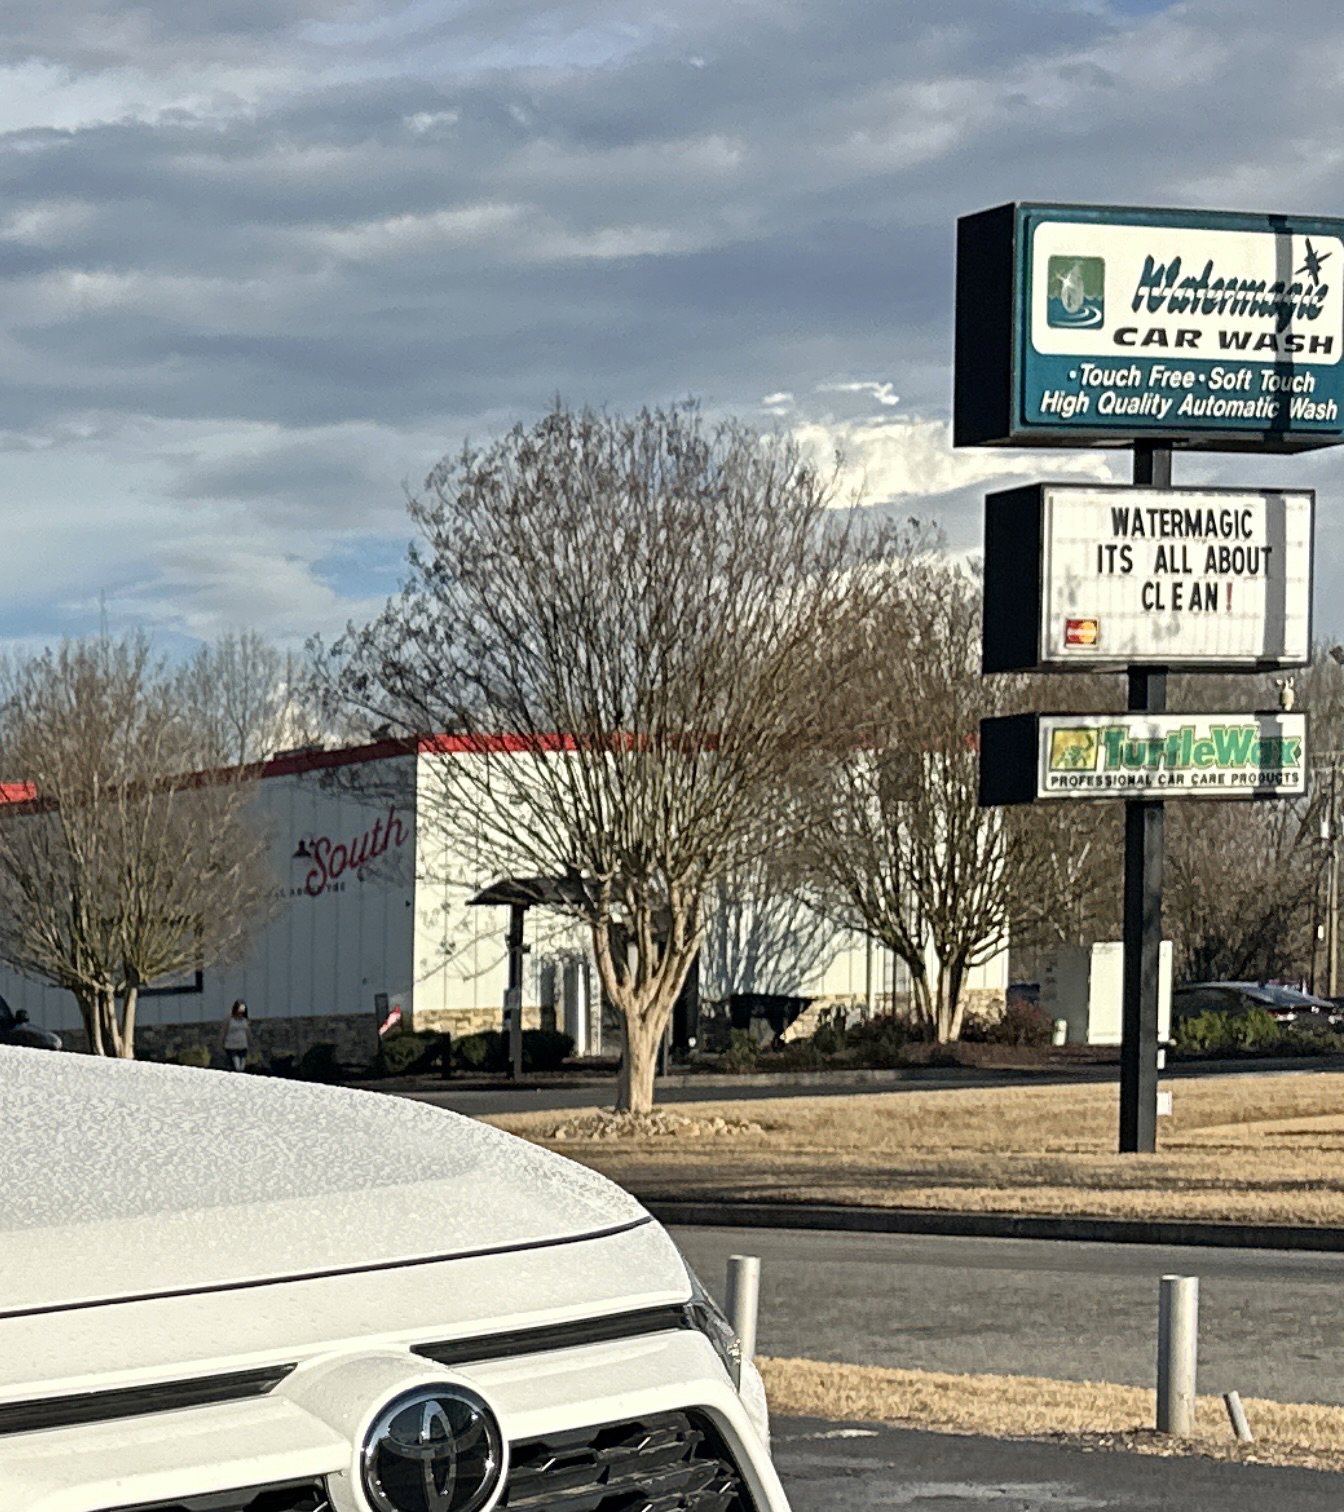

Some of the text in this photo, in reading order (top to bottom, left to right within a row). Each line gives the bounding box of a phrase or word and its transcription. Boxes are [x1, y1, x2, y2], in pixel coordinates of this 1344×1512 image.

[1113, 327, 1334, 354] CAR WASH
[1080, 363, 1316, 392] Touch Free Soft Touch
[1040, 390, 1338, 420] High Quality Automatic Wash
[1111, 507, 1253, 537] WATERMAGIC
[1097, 544, 1272, 575] ITS ALL ABOUT
[1050, 772, 1299, 787] PROFESSIONAL CAR CARE PRODUCTS
[306, 804, 409, 896] South
